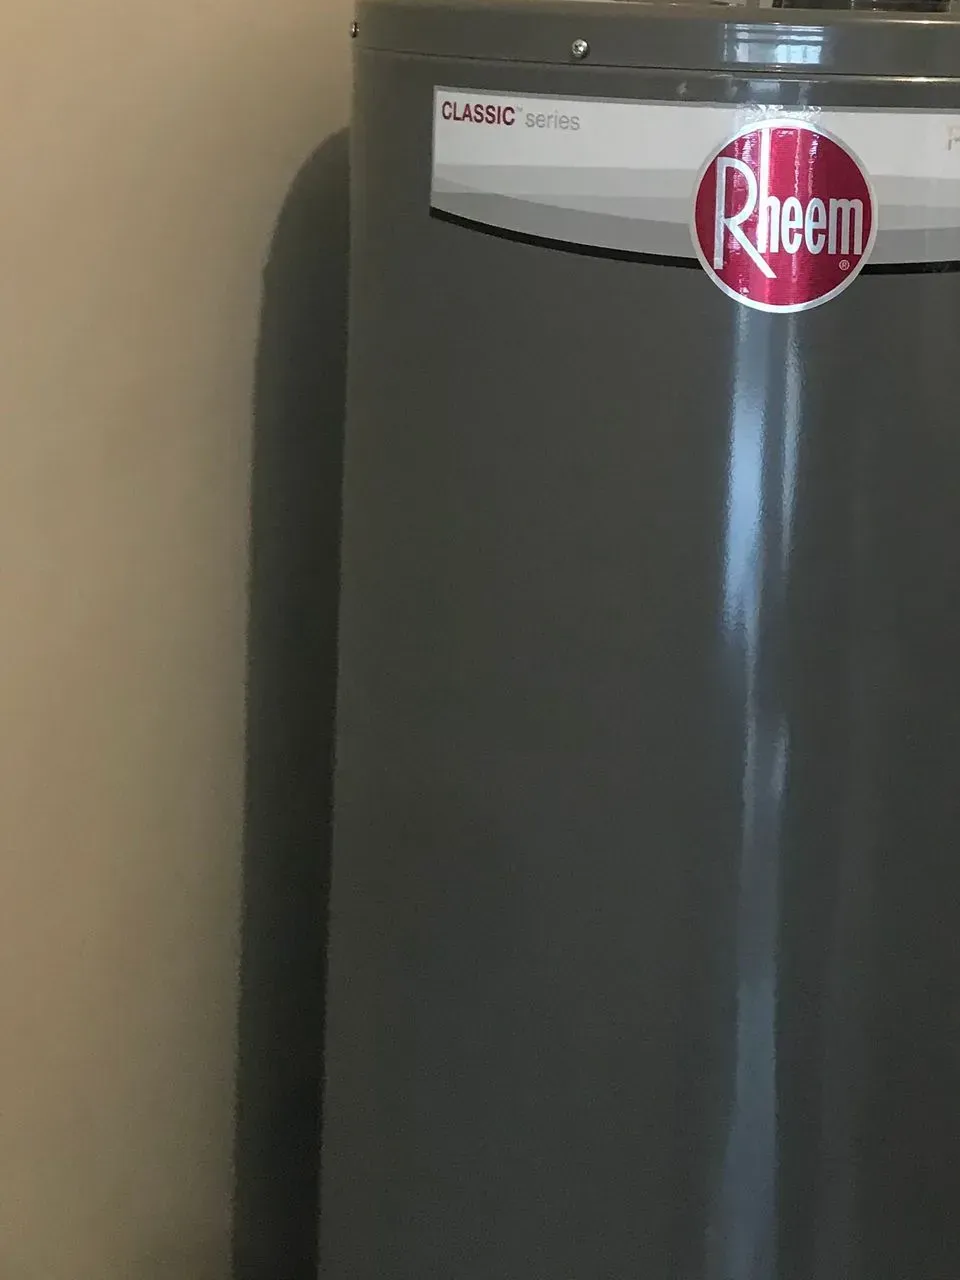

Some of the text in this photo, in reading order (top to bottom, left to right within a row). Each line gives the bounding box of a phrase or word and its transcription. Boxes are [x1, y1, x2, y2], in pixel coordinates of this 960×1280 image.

[442, 101, 581, 130] CLASSIC series
[714, 130, 863, 279] Rheem
